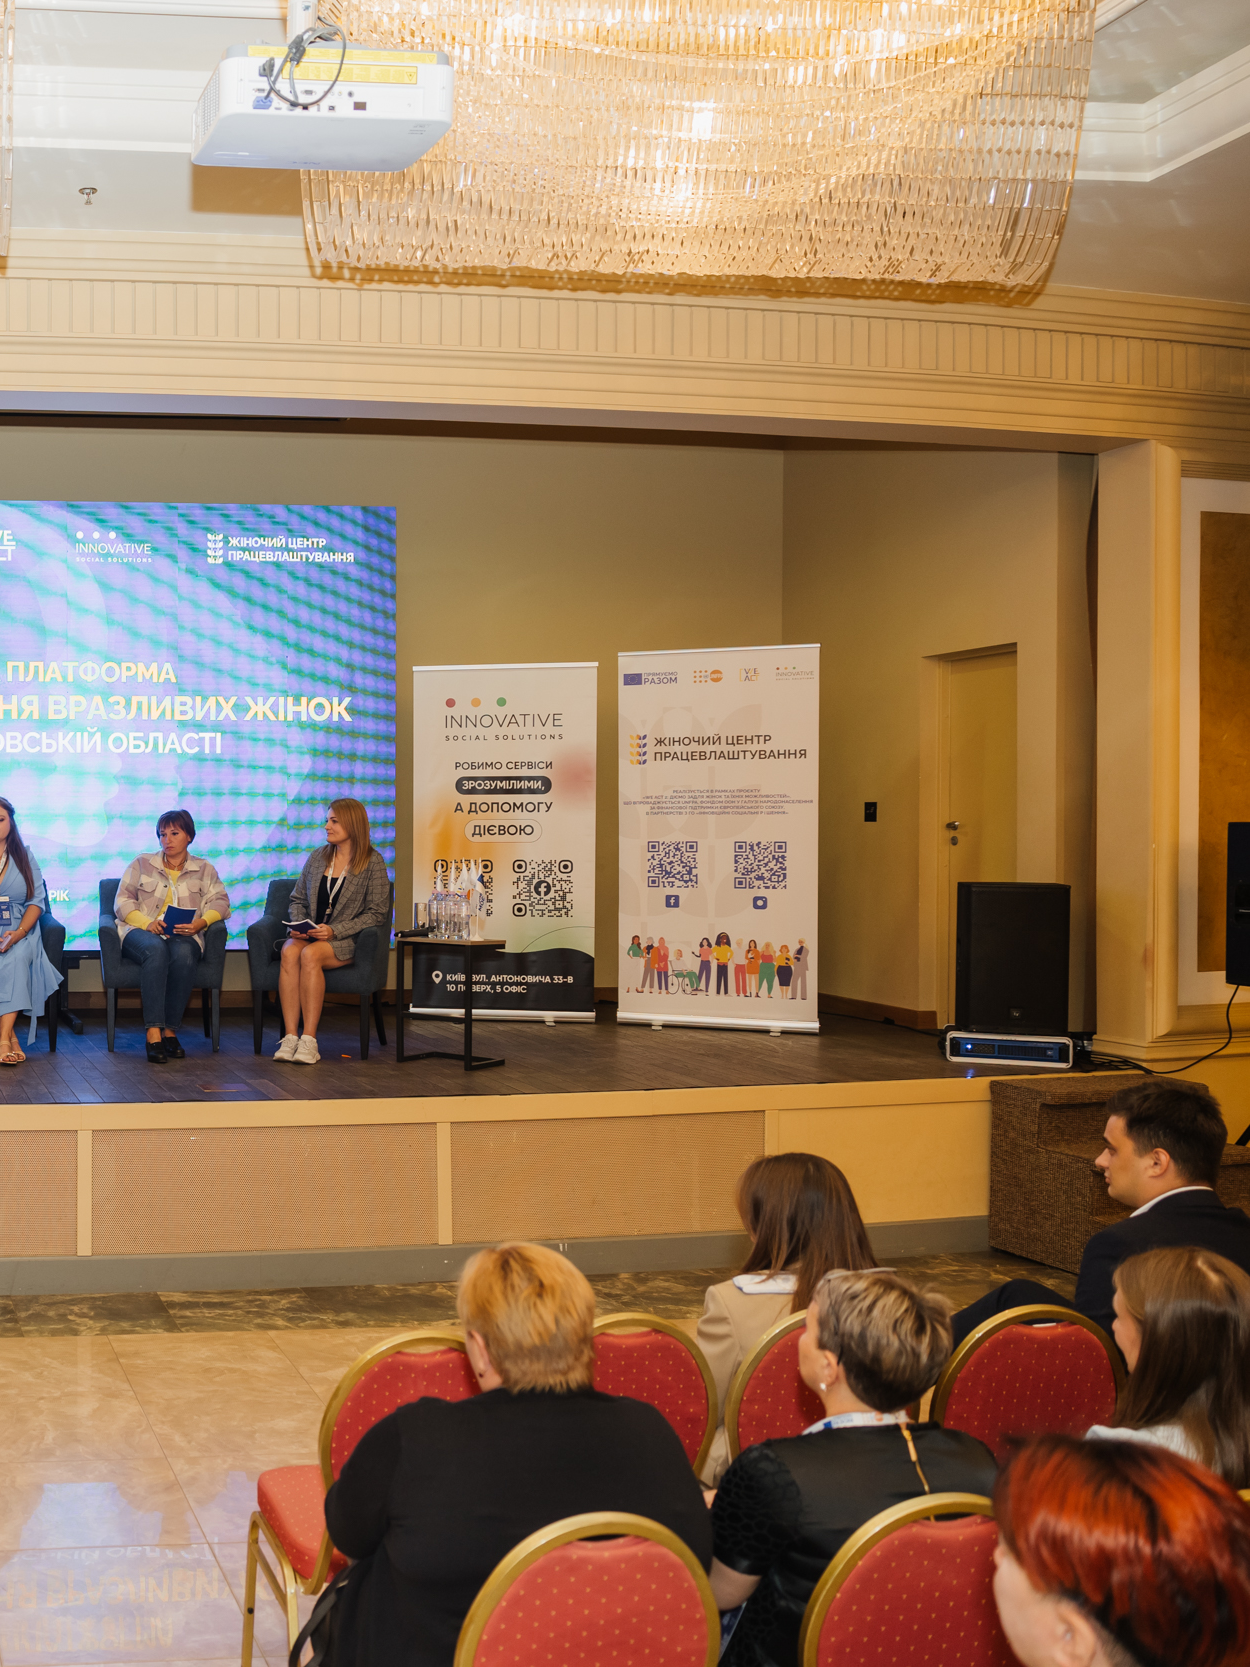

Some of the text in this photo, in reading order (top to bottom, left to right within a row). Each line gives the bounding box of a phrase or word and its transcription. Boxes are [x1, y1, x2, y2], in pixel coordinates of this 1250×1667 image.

[76, 543, 152, 554] INNOVATIVE
[228, 535, 326, 549] ЖІНОЧИЙ ЦЕНТР
[228, 550, 354, 563] ПРАЦЕВЛАШТУВАННЯ
[6, 661, 177, 683] ПЛАТФОРМА
[47, 695, 238, 721] ВРАЗЛИВИХ
[244, 696, 353, 722] ЖІНОК
[445, 713, 563, 728] INNOVATIVE
[108, 732, 222, 754] ОБЛАСТІ
[654, 734, 772, 747] ЖІНОЧИЙ ЦЕНТР
[654, 749, 807, 762] ПРАЦЕВЛАШТУВАННЯ
[455, 761, 553, 770] РОБИМО СЕРВІСИ
[462, 780, 545, 791] ЗРОЗУМІЛИМИ,
[454, 802, 553, 815] А ДОПОМОГУ
[472, 824, 534, 837] ДІЄВОЮ
[490, 975, 551, 983] АНТОНОВИЧА
